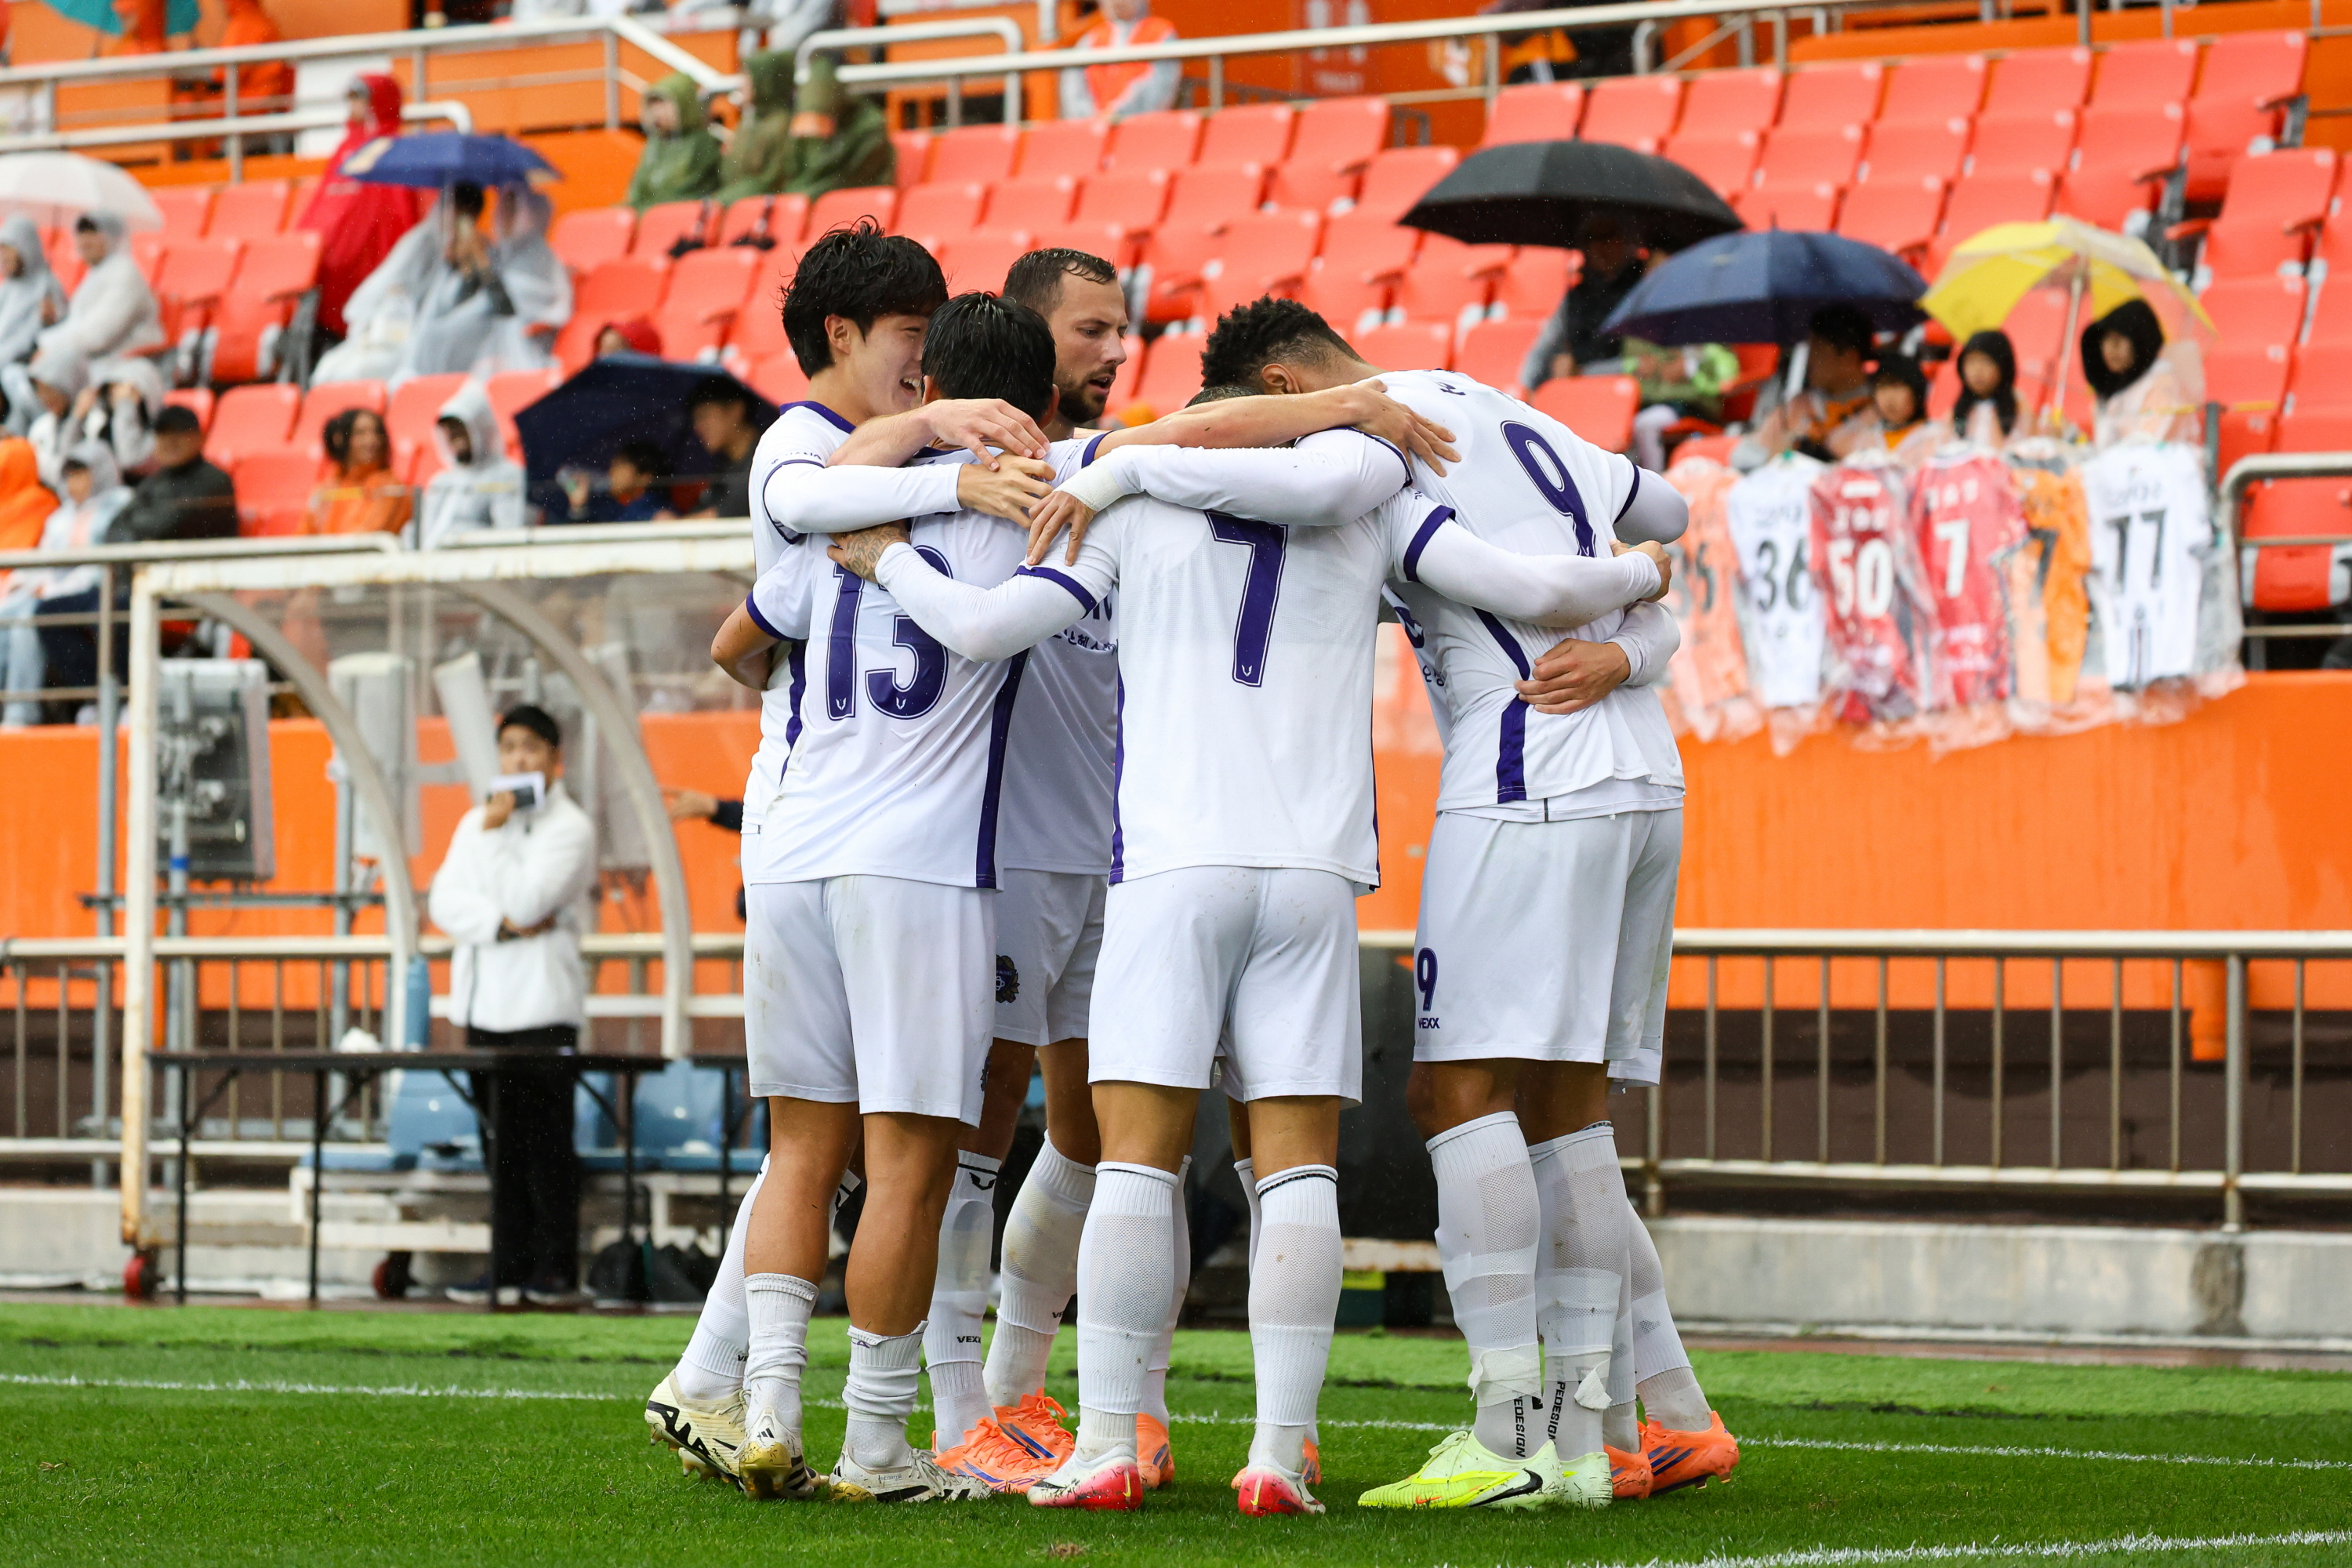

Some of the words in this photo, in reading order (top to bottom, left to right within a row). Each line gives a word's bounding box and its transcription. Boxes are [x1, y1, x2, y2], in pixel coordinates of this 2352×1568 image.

[1501, 420, 1597, 558] 9
[1203, 510, 1289, 688] 7
[1756, 535, 1812, 612] 36
[1828, 536, 1894, 619] 50
[1934, 517, 1969, 600] 7
[2026, 528, 2060, 608] 7
[826, 544, 954, 720] 13
[1417, 947, 1438, 1011] 9
[1417, 1018, 1440, 1029] VEXX
[1513, 1396, 1526, 1457] EDESIGN
